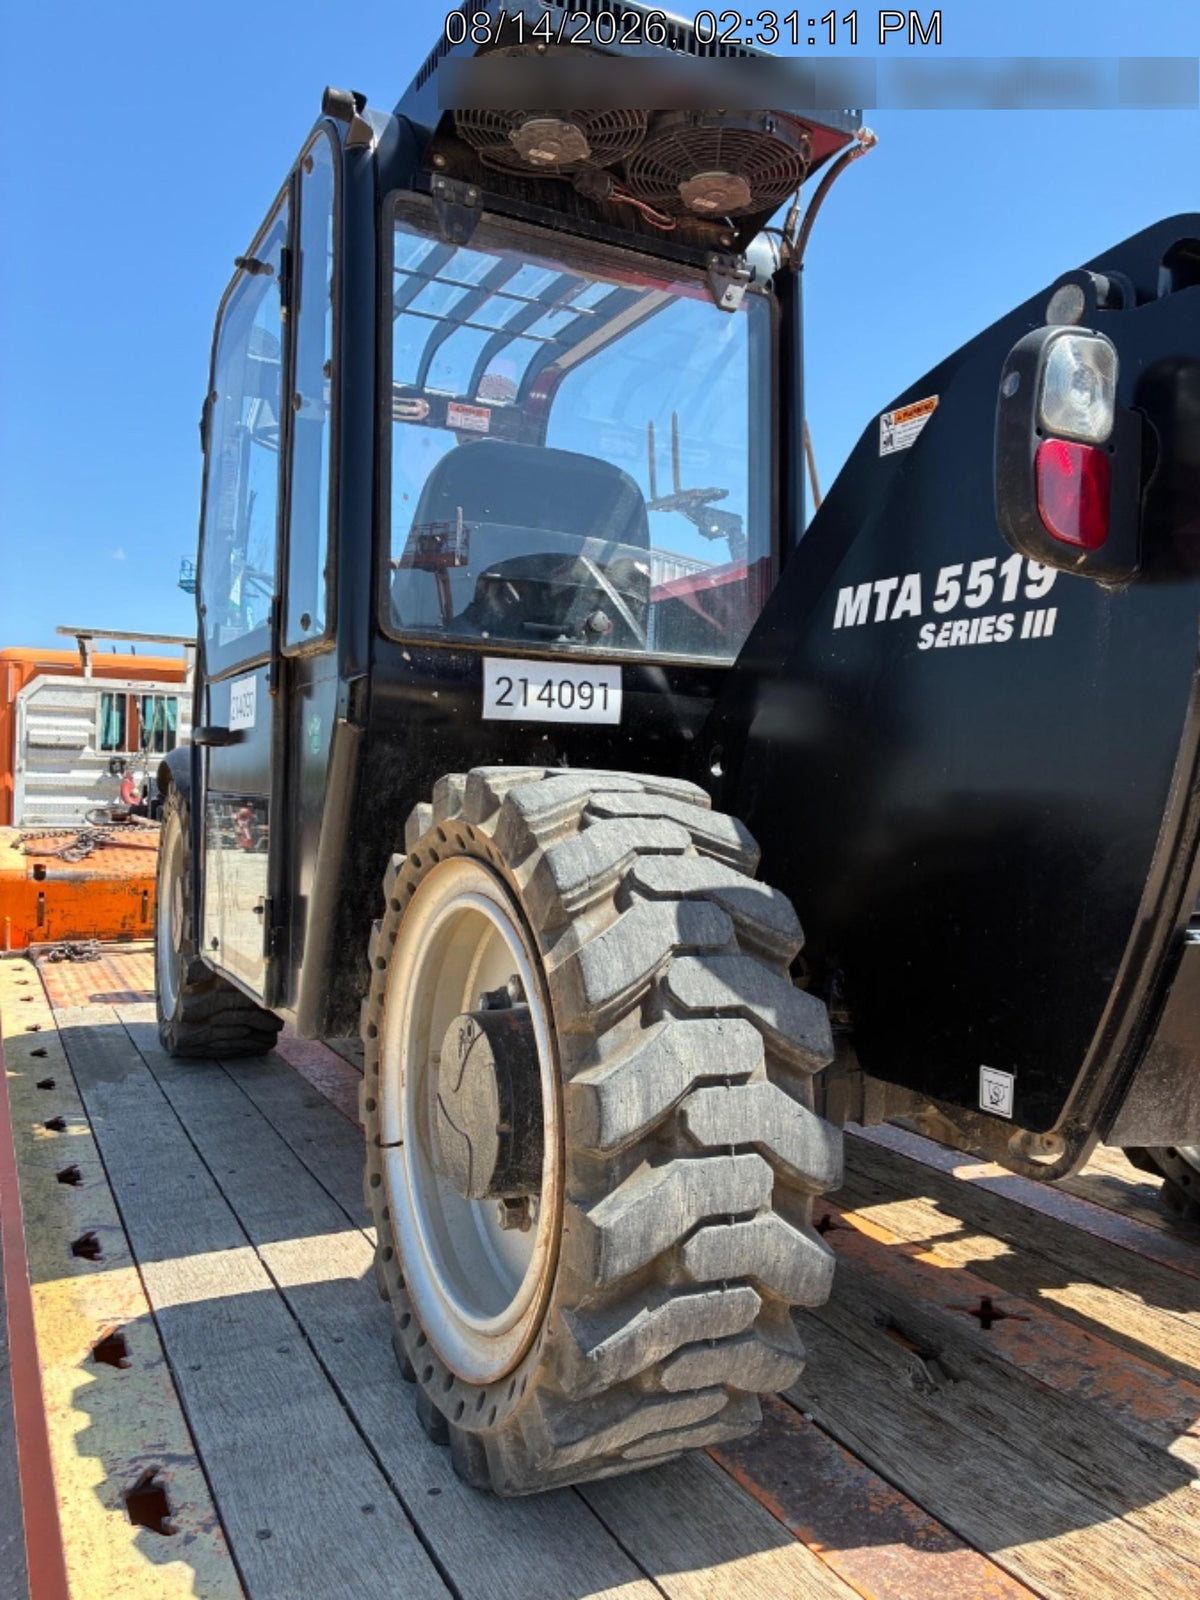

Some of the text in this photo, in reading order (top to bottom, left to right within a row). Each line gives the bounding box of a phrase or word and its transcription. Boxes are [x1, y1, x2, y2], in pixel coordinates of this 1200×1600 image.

[833, 552, 1058, 630] MTA 5519
[917, 607, 1058, 650] SERIES III
[495, 676, 608, 711] 214091
